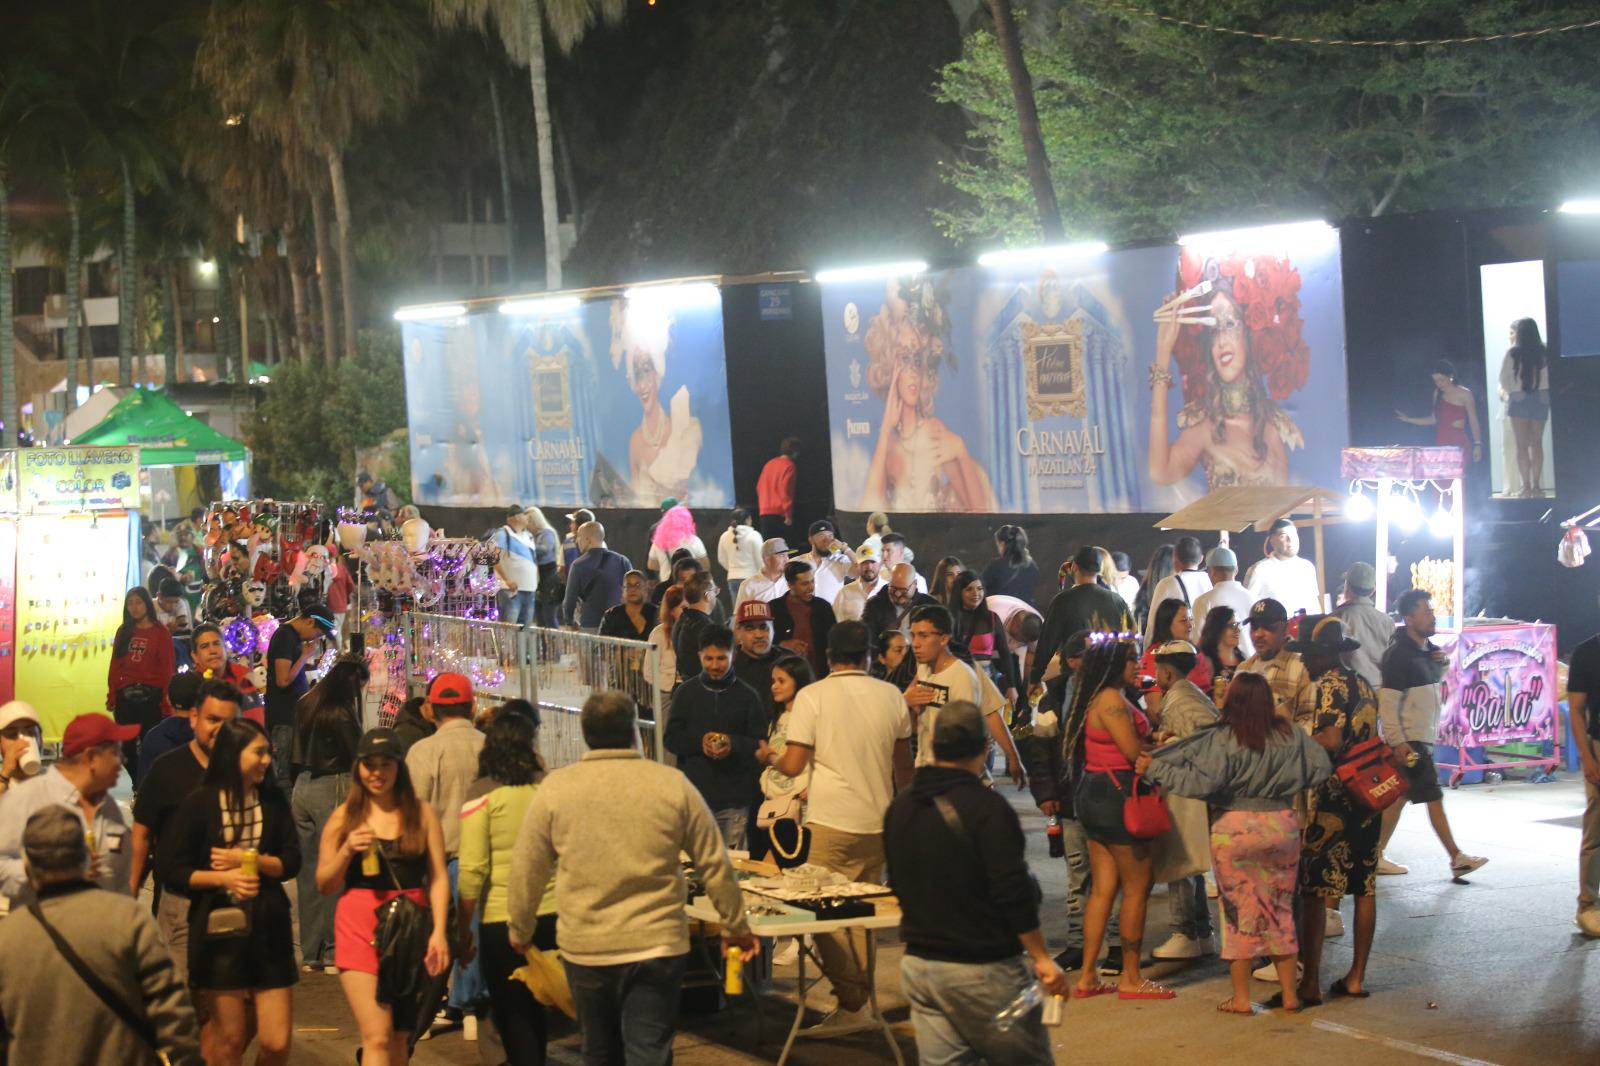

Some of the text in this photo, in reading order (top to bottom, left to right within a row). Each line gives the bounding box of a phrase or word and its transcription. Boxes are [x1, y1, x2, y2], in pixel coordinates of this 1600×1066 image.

[528, 436, 585, 461] CARNAVAL
[1017, 425, 1105, 456] CARNAVAL
[26, 448, 133, 467] FOTO LLAVERO
[74, 467, 85, 479] A
[56, 479, 105, 493] COLOR
[1368, 774, 1400, 799] TECATE
